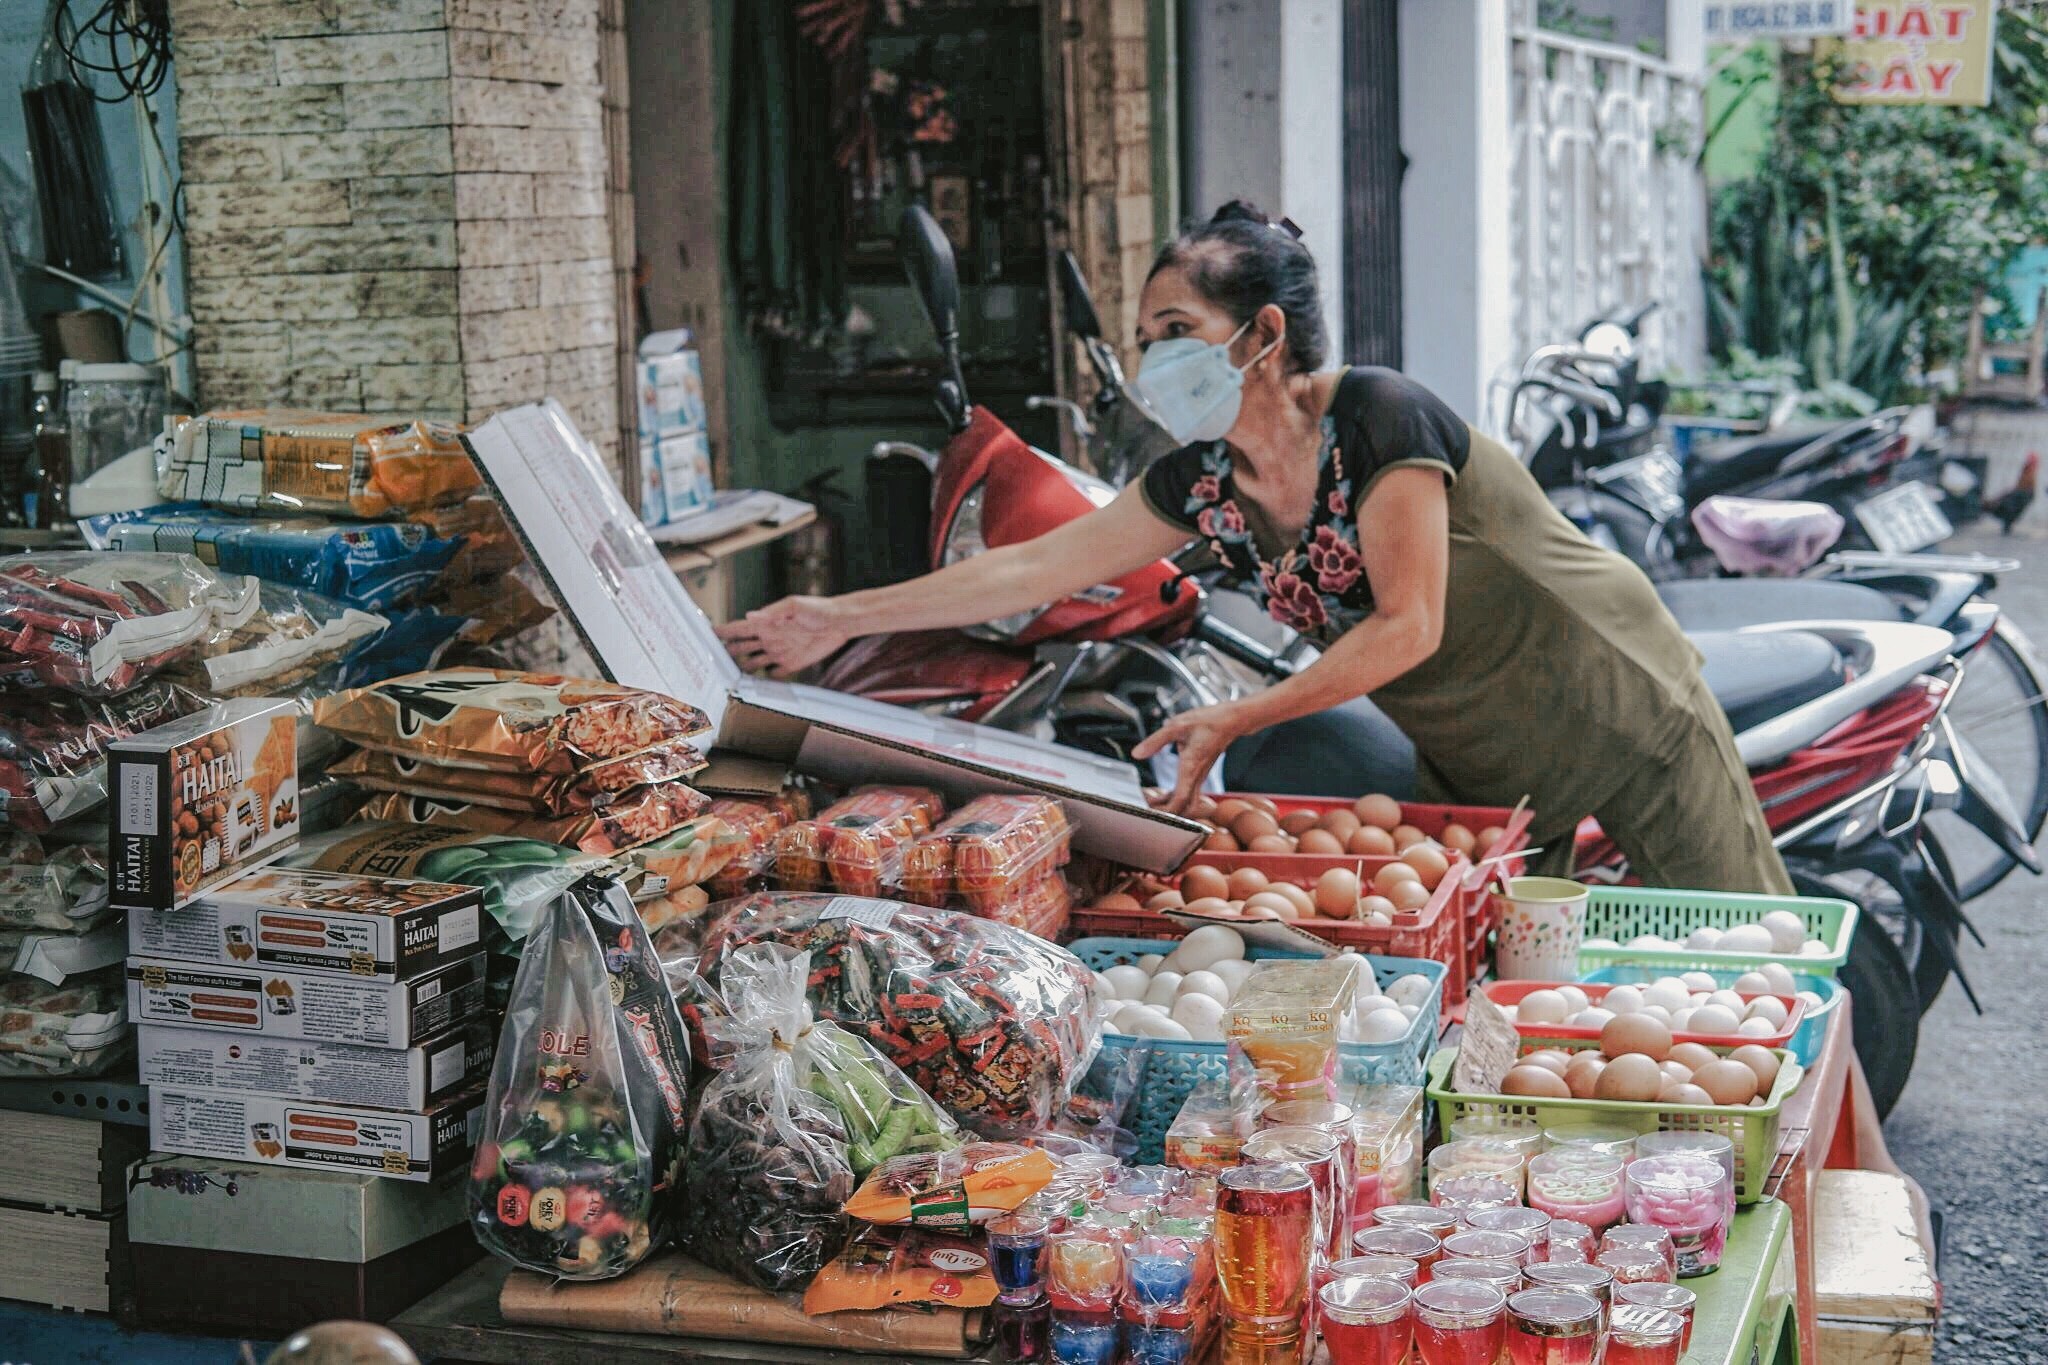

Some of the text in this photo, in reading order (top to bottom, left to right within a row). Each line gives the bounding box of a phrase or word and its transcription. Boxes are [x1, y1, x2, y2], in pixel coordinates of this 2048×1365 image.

[182, 750, 243, 805] HAITAI
[127, 837, 141, 892] HAITAI
[404, 924, 438, 947] HAITAI
[1271, 1014, 1289, 1024] KQ
[1310, 1011, 1328, 1022] KQ
[437, 1119, 466, 1145] HAITAI
